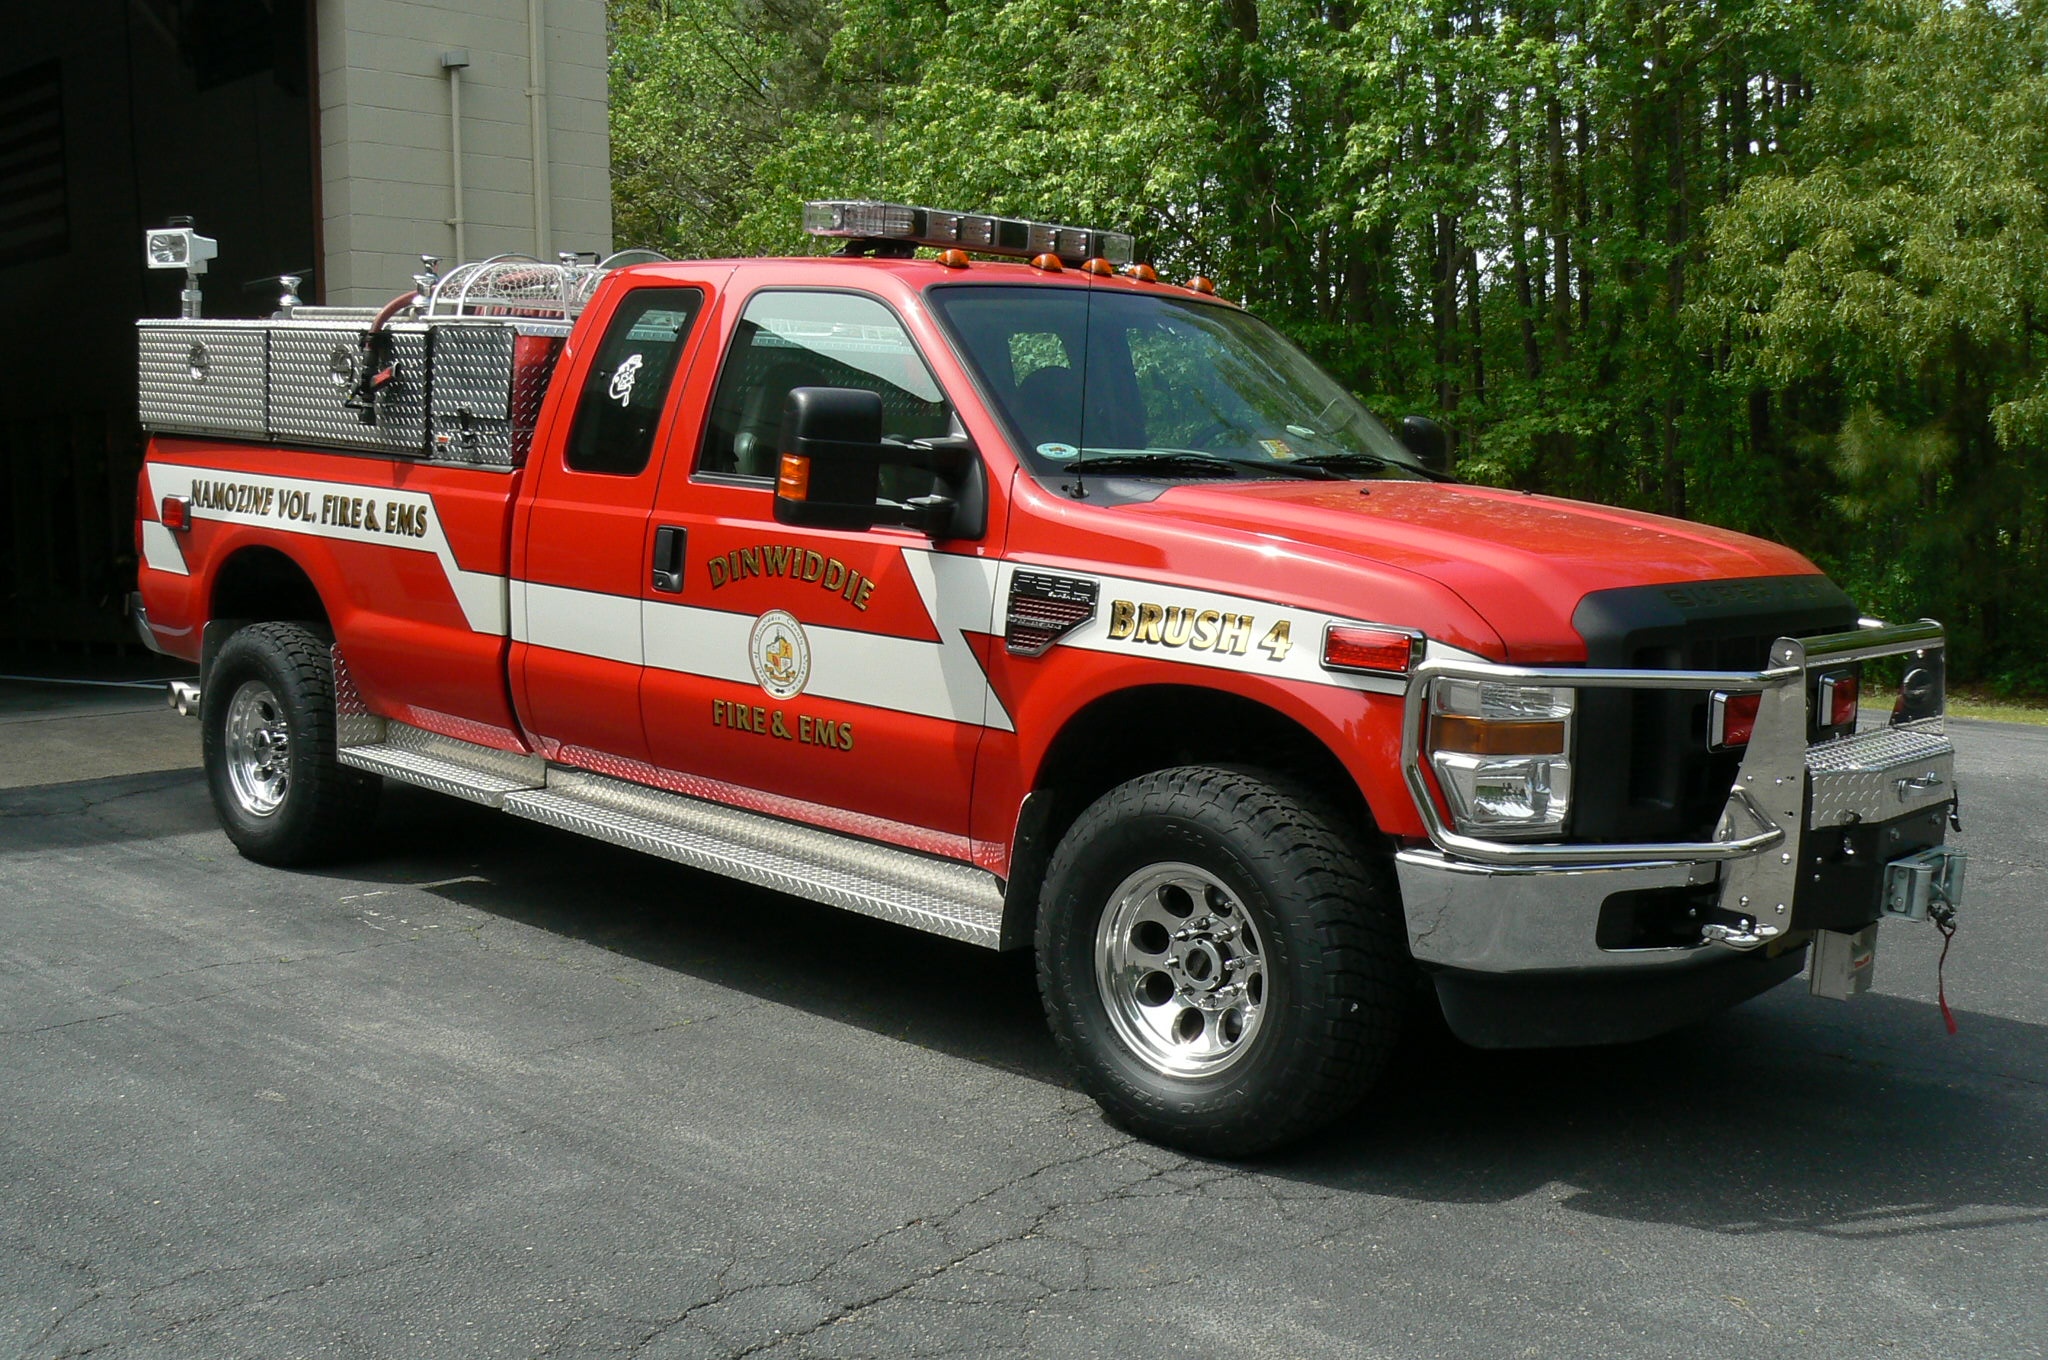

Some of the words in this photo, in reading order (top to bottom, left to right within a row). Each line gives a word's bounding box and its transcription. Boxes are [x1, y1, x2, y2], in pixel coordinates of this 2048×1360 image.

[190, 479, 274, 516] NAMOZINE
[279, 489, 317, 523] VOL.
[385, 501, 428, 538] EMS
[708, 545, 876, 611] DINWIDDIE
[1107, 599, 1255, 656] BRUSH
[1257, 620, 1294, 662] 4
[799, 714, 855, 752] EMS
